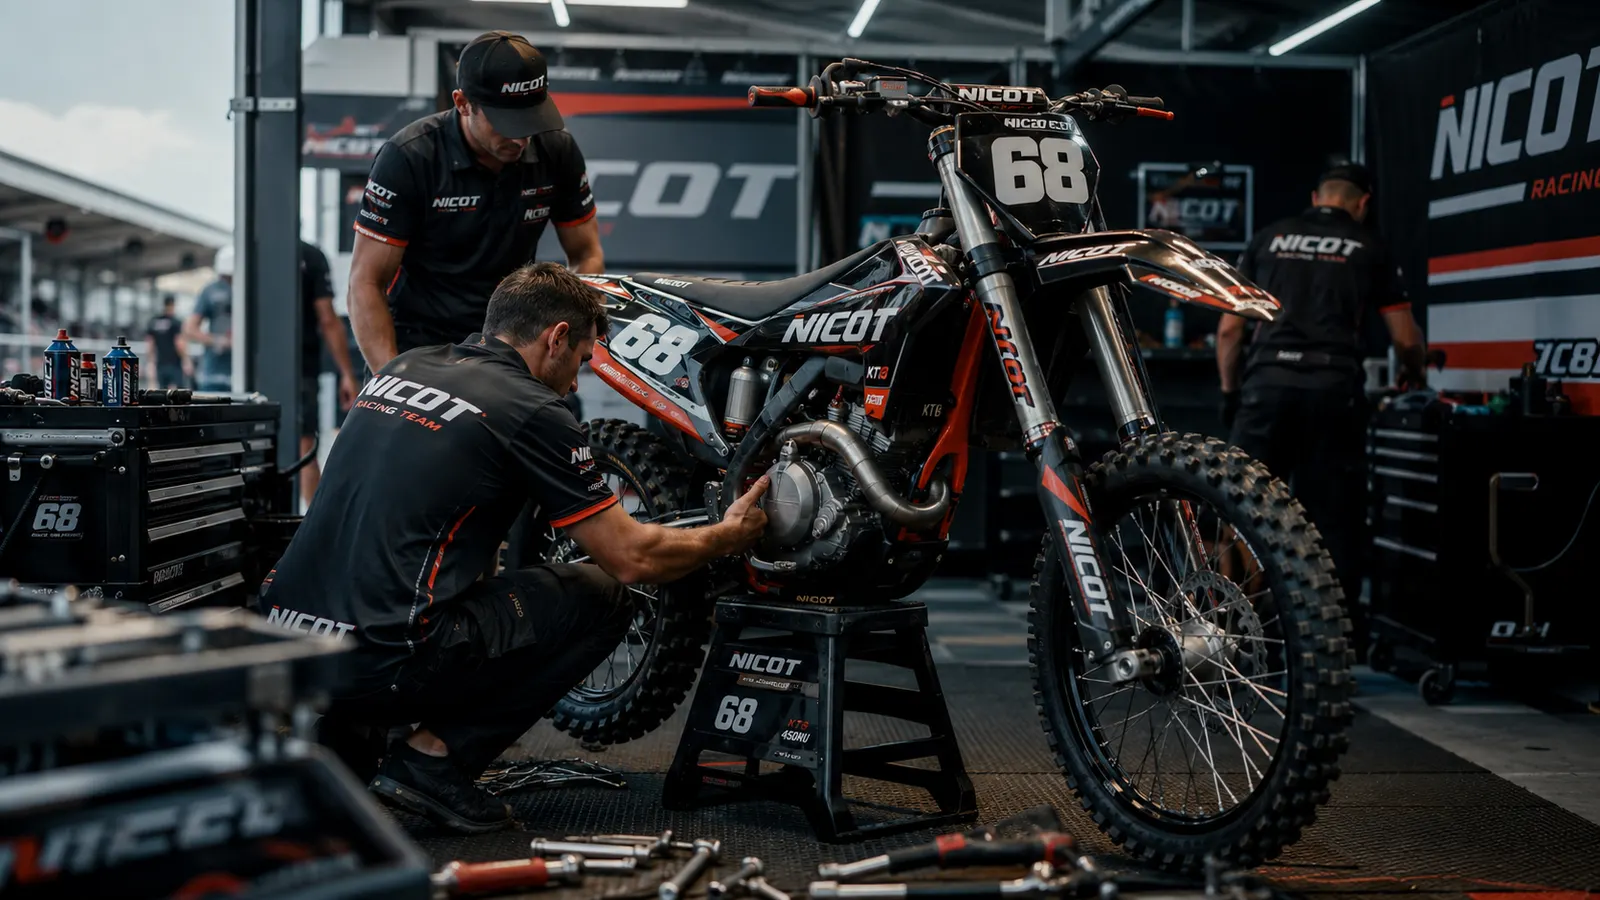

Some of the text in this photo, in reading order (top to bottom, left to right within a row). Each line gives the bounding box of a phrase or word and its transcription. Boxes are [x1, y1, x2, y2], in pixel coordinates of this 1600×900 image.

[501, 75, 545, 93] NICOT
[958, 85, 1037, 103] NICOT
[991, 136, 1089, 205] 68
[432, 195, 481, 208] NICOT
[1038, 243, 1137, 267] NICOT
[1268, 234, 1364, 256] NICOT
[780, 307, 902, 343] NICOT
[609, 313, 699, 376] 68
[358, 374, 483, 422] NICOT
[355, 400, 443, 431] RACING TEAM
[32, 503, 82, 531] 68
[1062, 519, 1115, 620] NICOT
[796, 595, 835, 604] NICOT
[266, 604, 356, 642] NICOT
[728, 651, 802, 676] NICOT
[714, 694, 758, 734] 68
